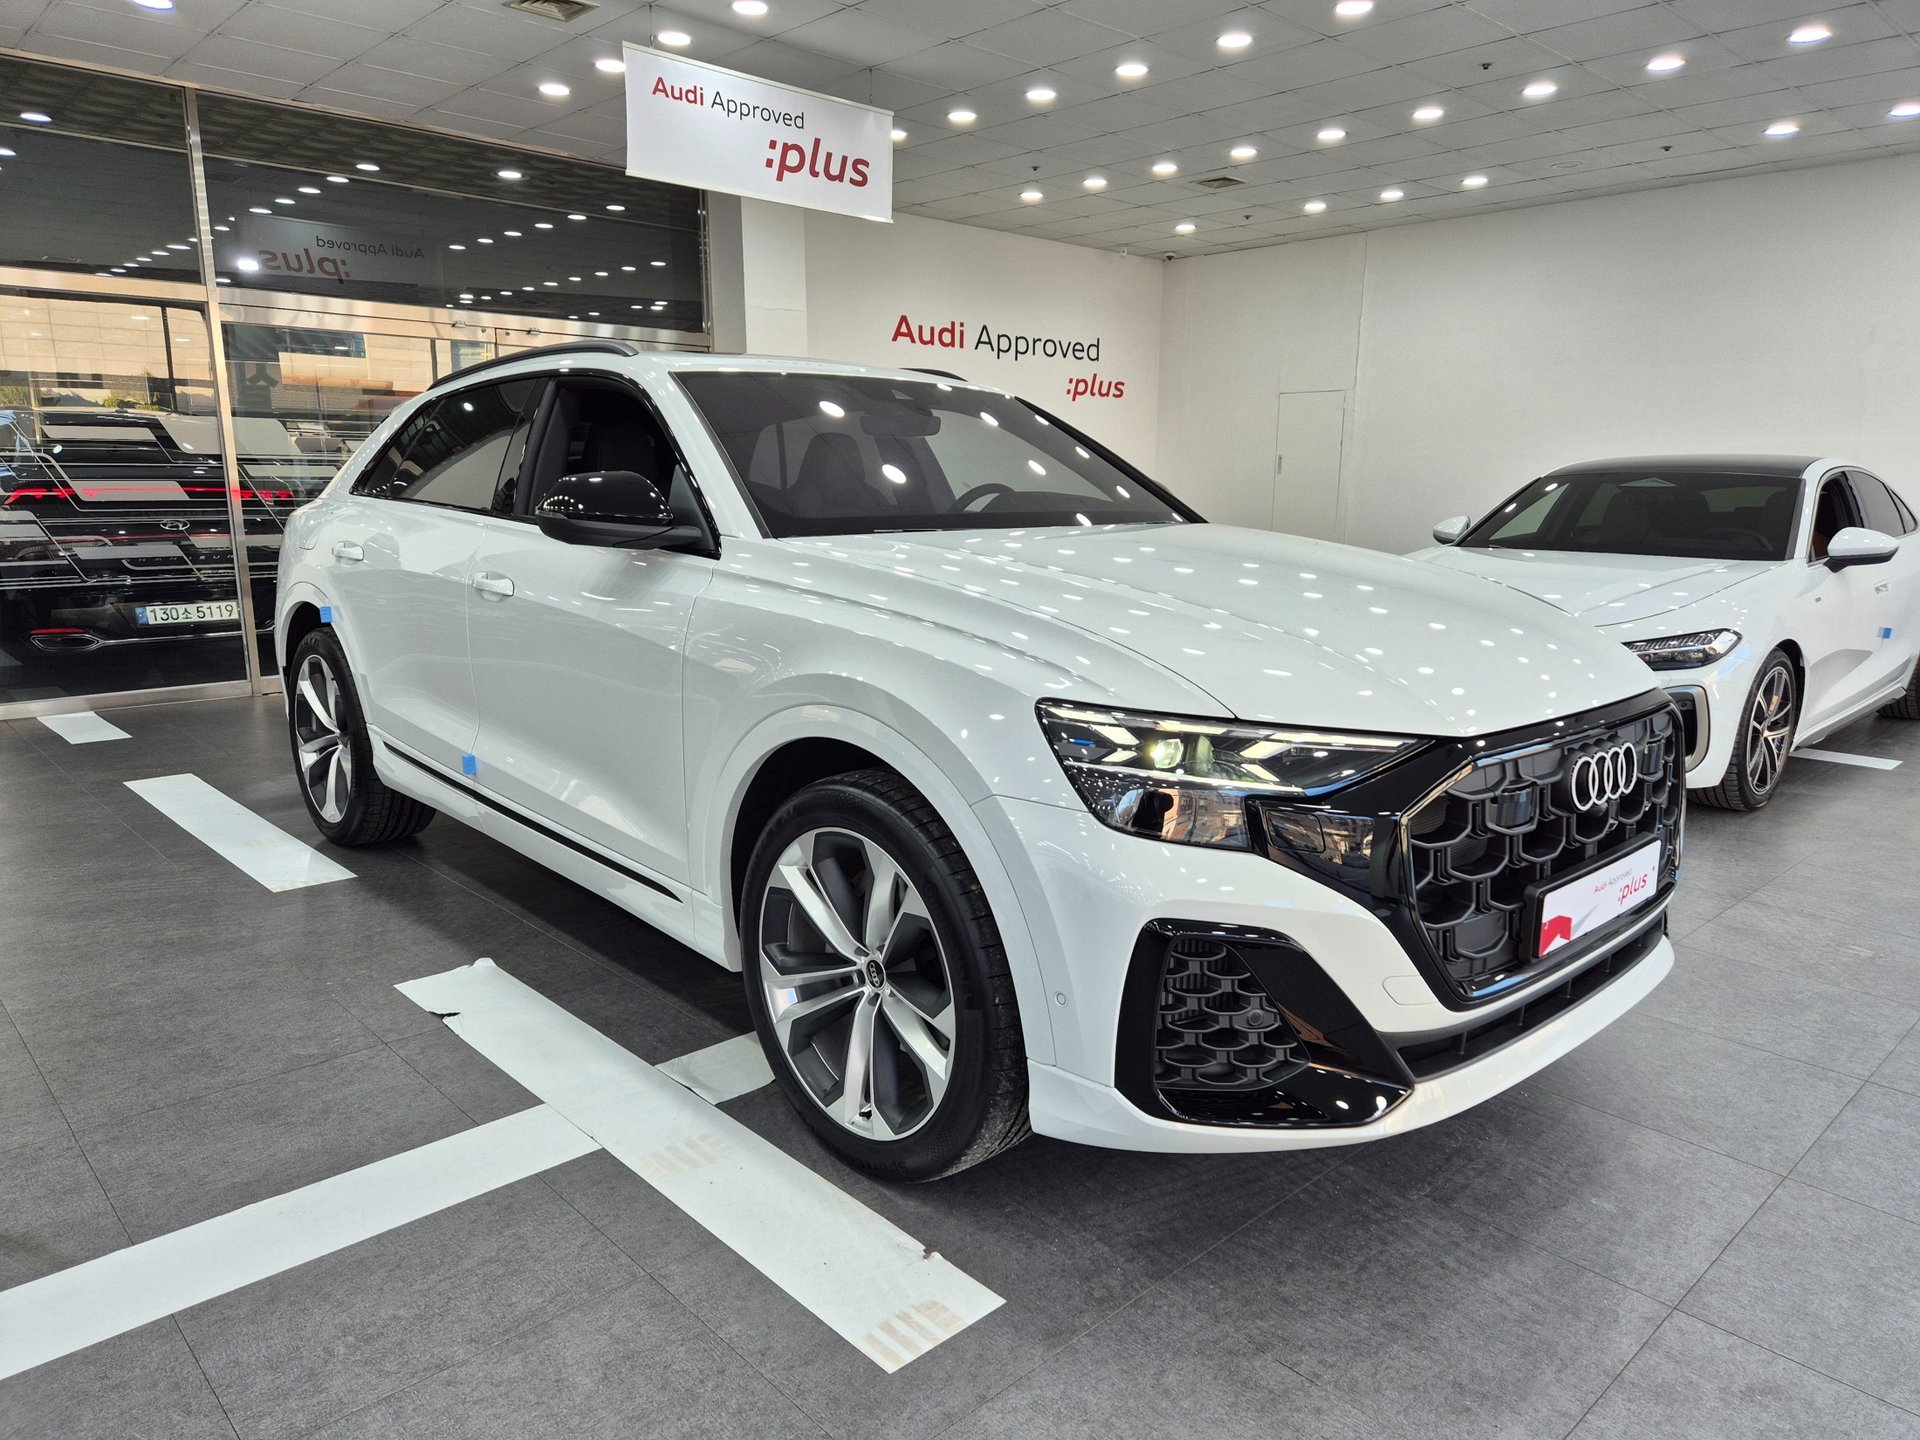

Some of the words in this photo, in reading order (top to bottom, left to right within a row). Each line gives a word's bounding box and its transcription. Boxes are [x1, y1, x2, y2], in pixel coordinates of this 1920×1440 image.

[652, 76, 705, 106] Audi
[711, 90, 805, 130] Approved
[765, 137, 870, 188] :plus
[891, 314, 965, 349] Audi
[974, 324, 1100, 362] Approved
[1066, 373, 1126, 402] :plus
[149, 606, 193, 622] 130소
[196, 604, 235, 619] 5119
